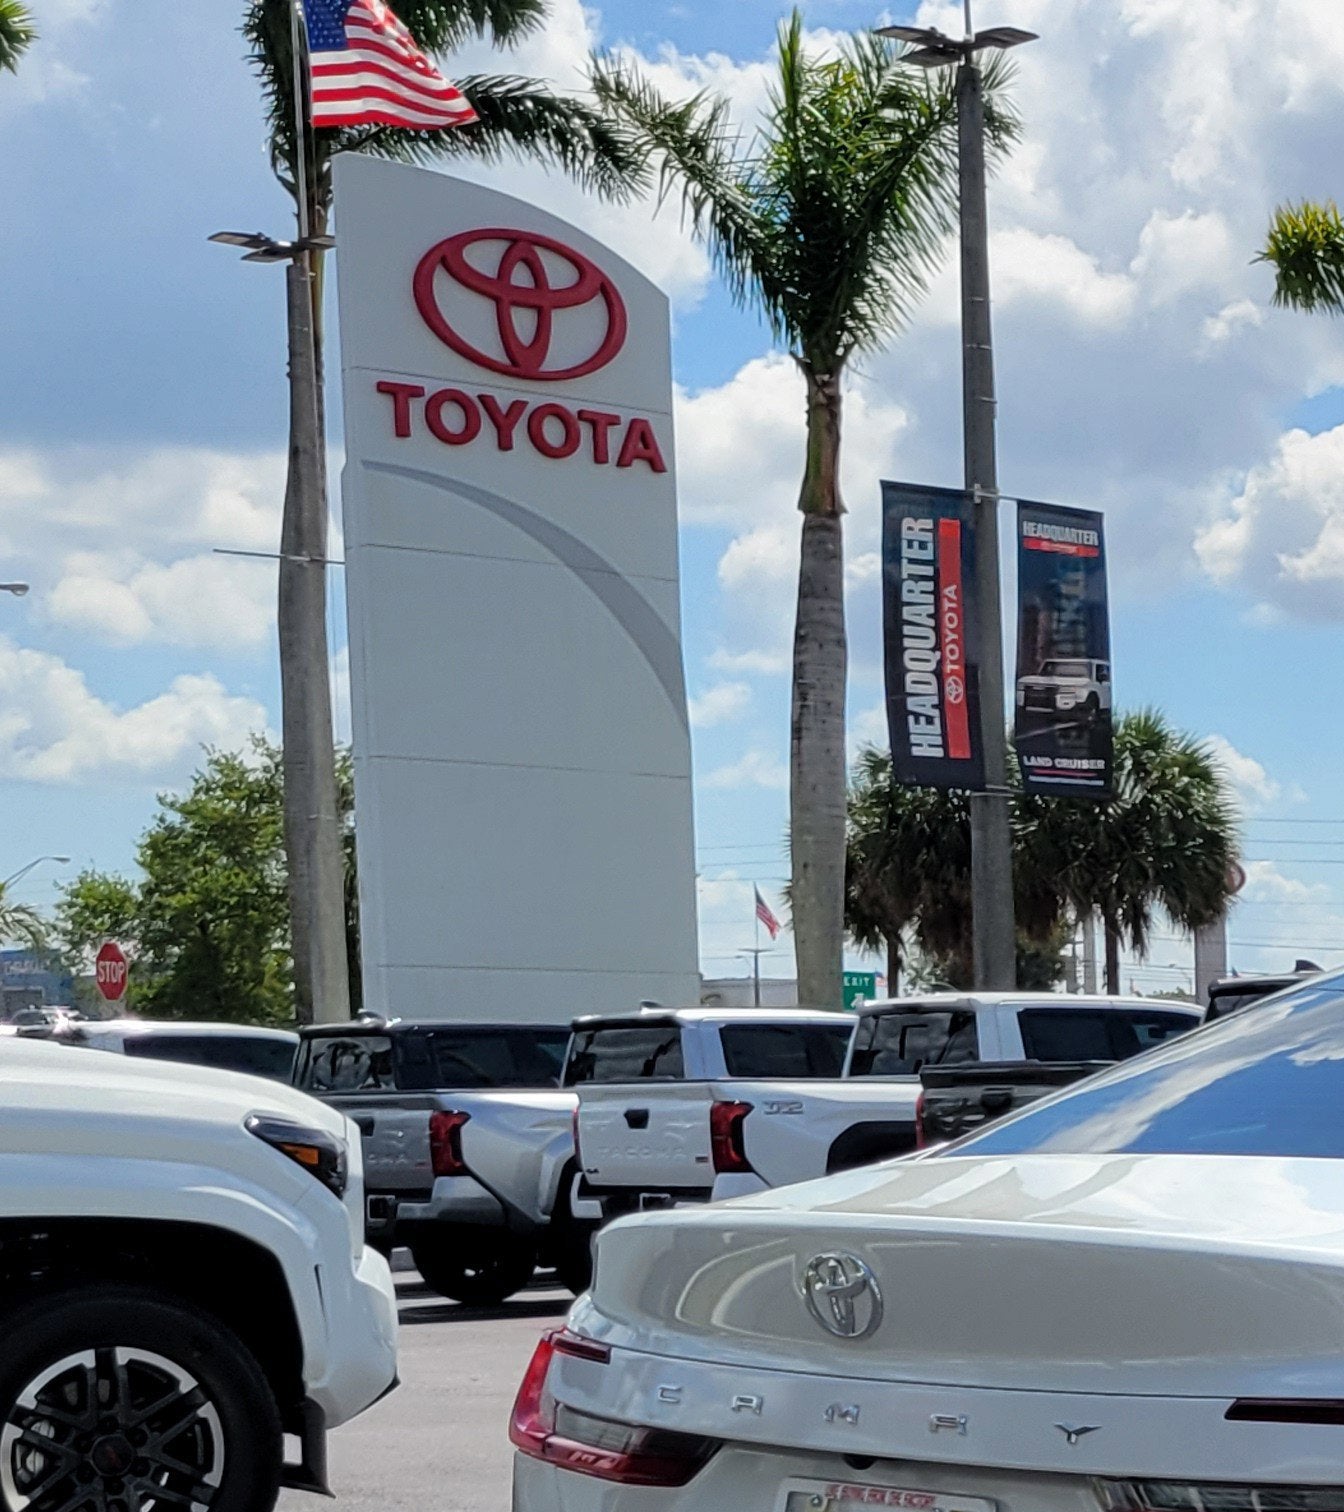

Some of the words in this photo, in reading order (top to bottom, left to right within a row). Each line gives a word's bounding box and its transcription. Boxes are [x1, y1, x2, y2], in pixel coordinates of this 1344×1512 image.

[376, 381, 667, 473] TOYOTA
[1022, 520, 1099, 546] HEADQUARTER
[901, 517, 944, 758] HEADQUARTER
[944, 584, 960, 673] TOYOTA
[1022, 755, 1053, 767] LAND
[1054, 758, 1105, 769] CRUISER
[98, 960, 125, 983] STOP
[656, 1384, 1103, 1445] CAMRY
